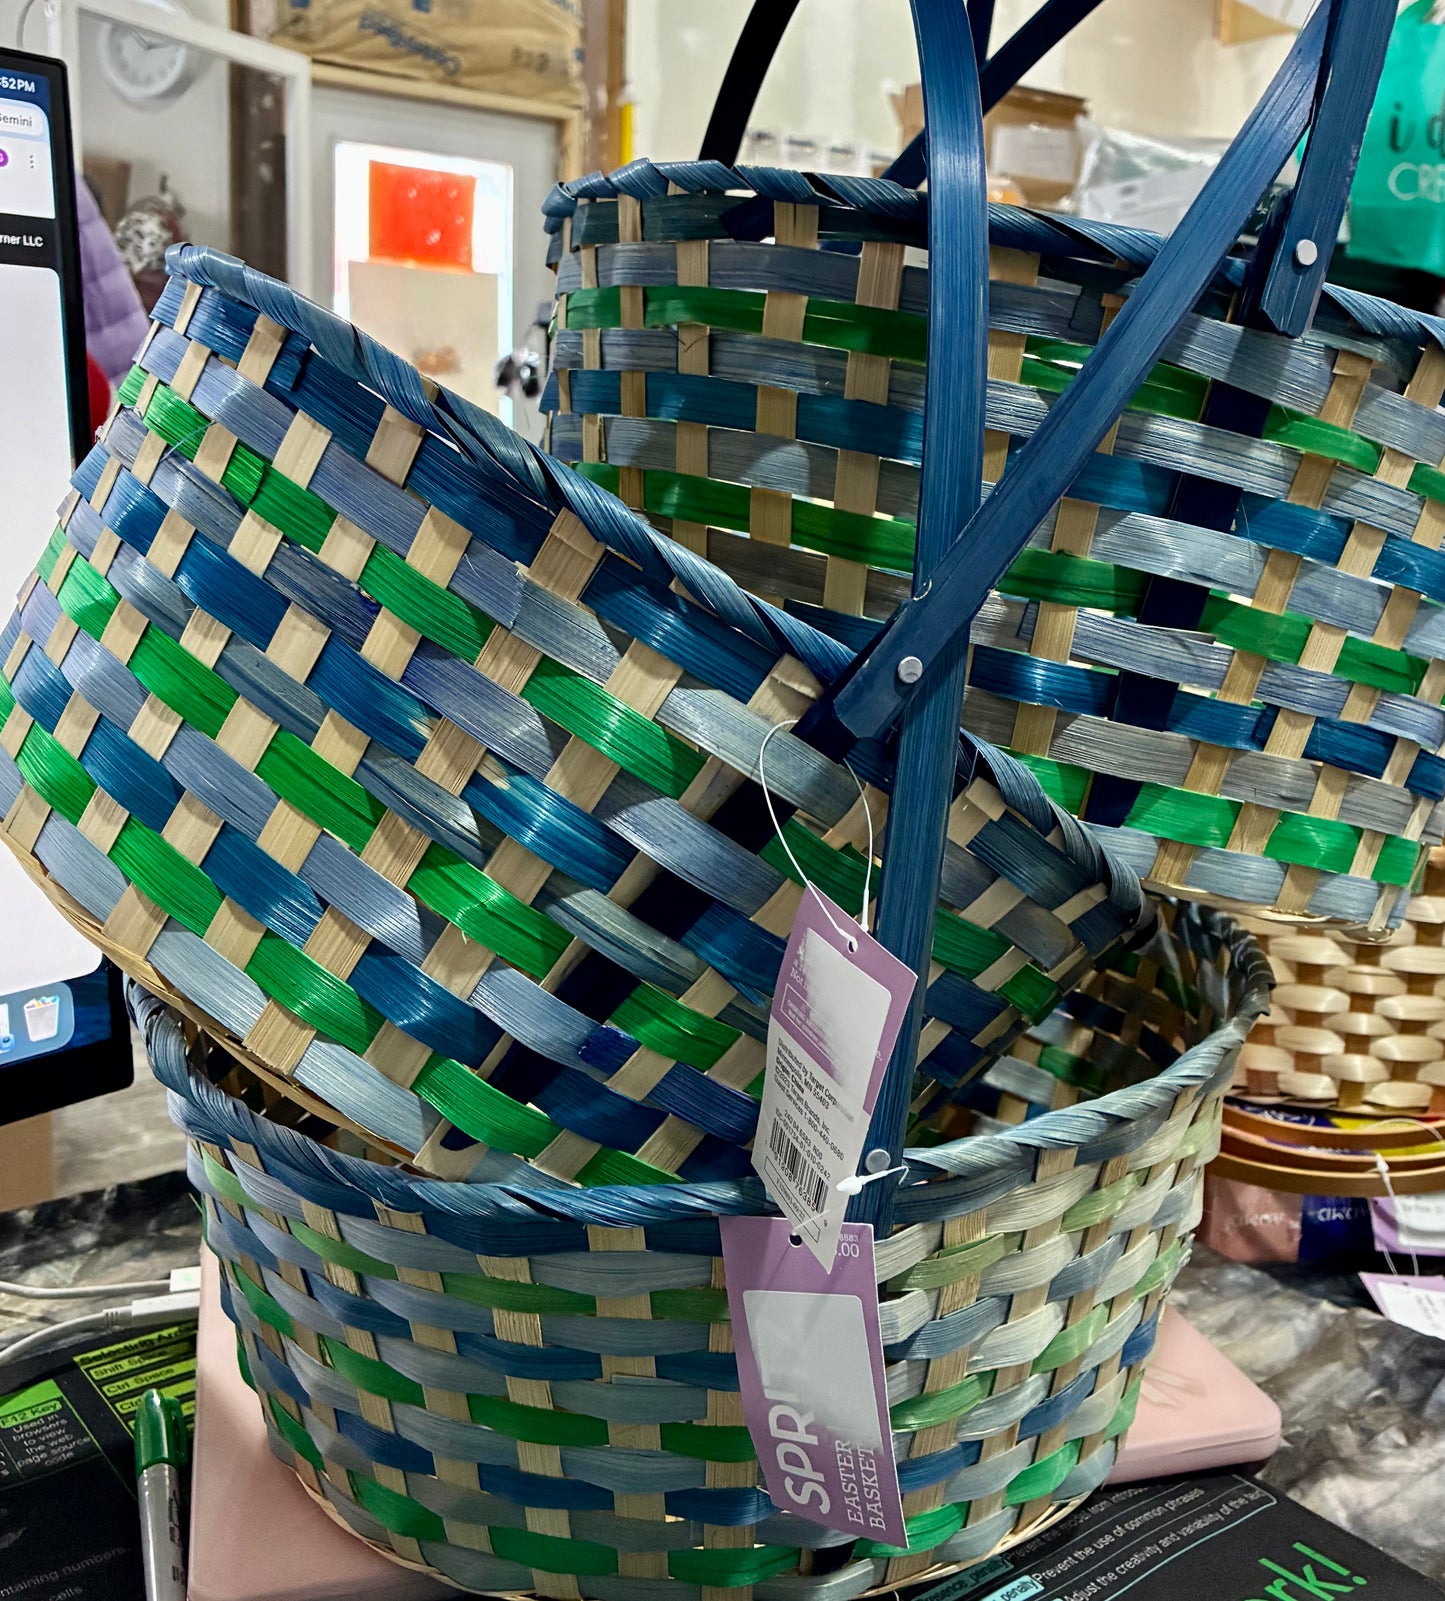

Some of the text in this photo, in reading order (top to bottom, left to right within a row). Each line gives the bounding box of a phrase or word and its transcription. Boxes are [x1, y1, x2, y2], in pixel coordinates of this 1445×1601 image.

[22, 235, 44, 248] LLC
[808, 1071, 825, 1093] Target
[93, 1363, 124, 1379] Shift
[105, 1381, 131, 1395] Ctrl
[30, 1402, 58, 1417] Key
[12, 1417, 46, 1434] Used
[12, 1418, 68, 1442] browsers
[23, 1428, 66, 1447] to view
[25, 1433, 74, 1456] the web
[17, 1452, 48, 1469] page
[50, 1436, 92, 1456] source
[834, 1438, 865, 1526] EASTER
[1031, 1555, 1079, 1584] Prevent
[1073, 1546, 1095, 1561] the
[1092, 1532, 1115, 1550] use
[1112, 1524, 1126, 1537] of
[1123, 1506, 1167, 1531] common
[1164, 1488, 1206, 1512] phrases
[1061, 1581, 1102, 1601] Adjust
[1095, 1571, 1118, 1587] the
[1115, 1539, 1163, 1575] creativity
[1157, 1531, 1182, 1548] and
[1219, 1501, 1235, 1516] of
[1230, 1494, 1249, 1509] the
